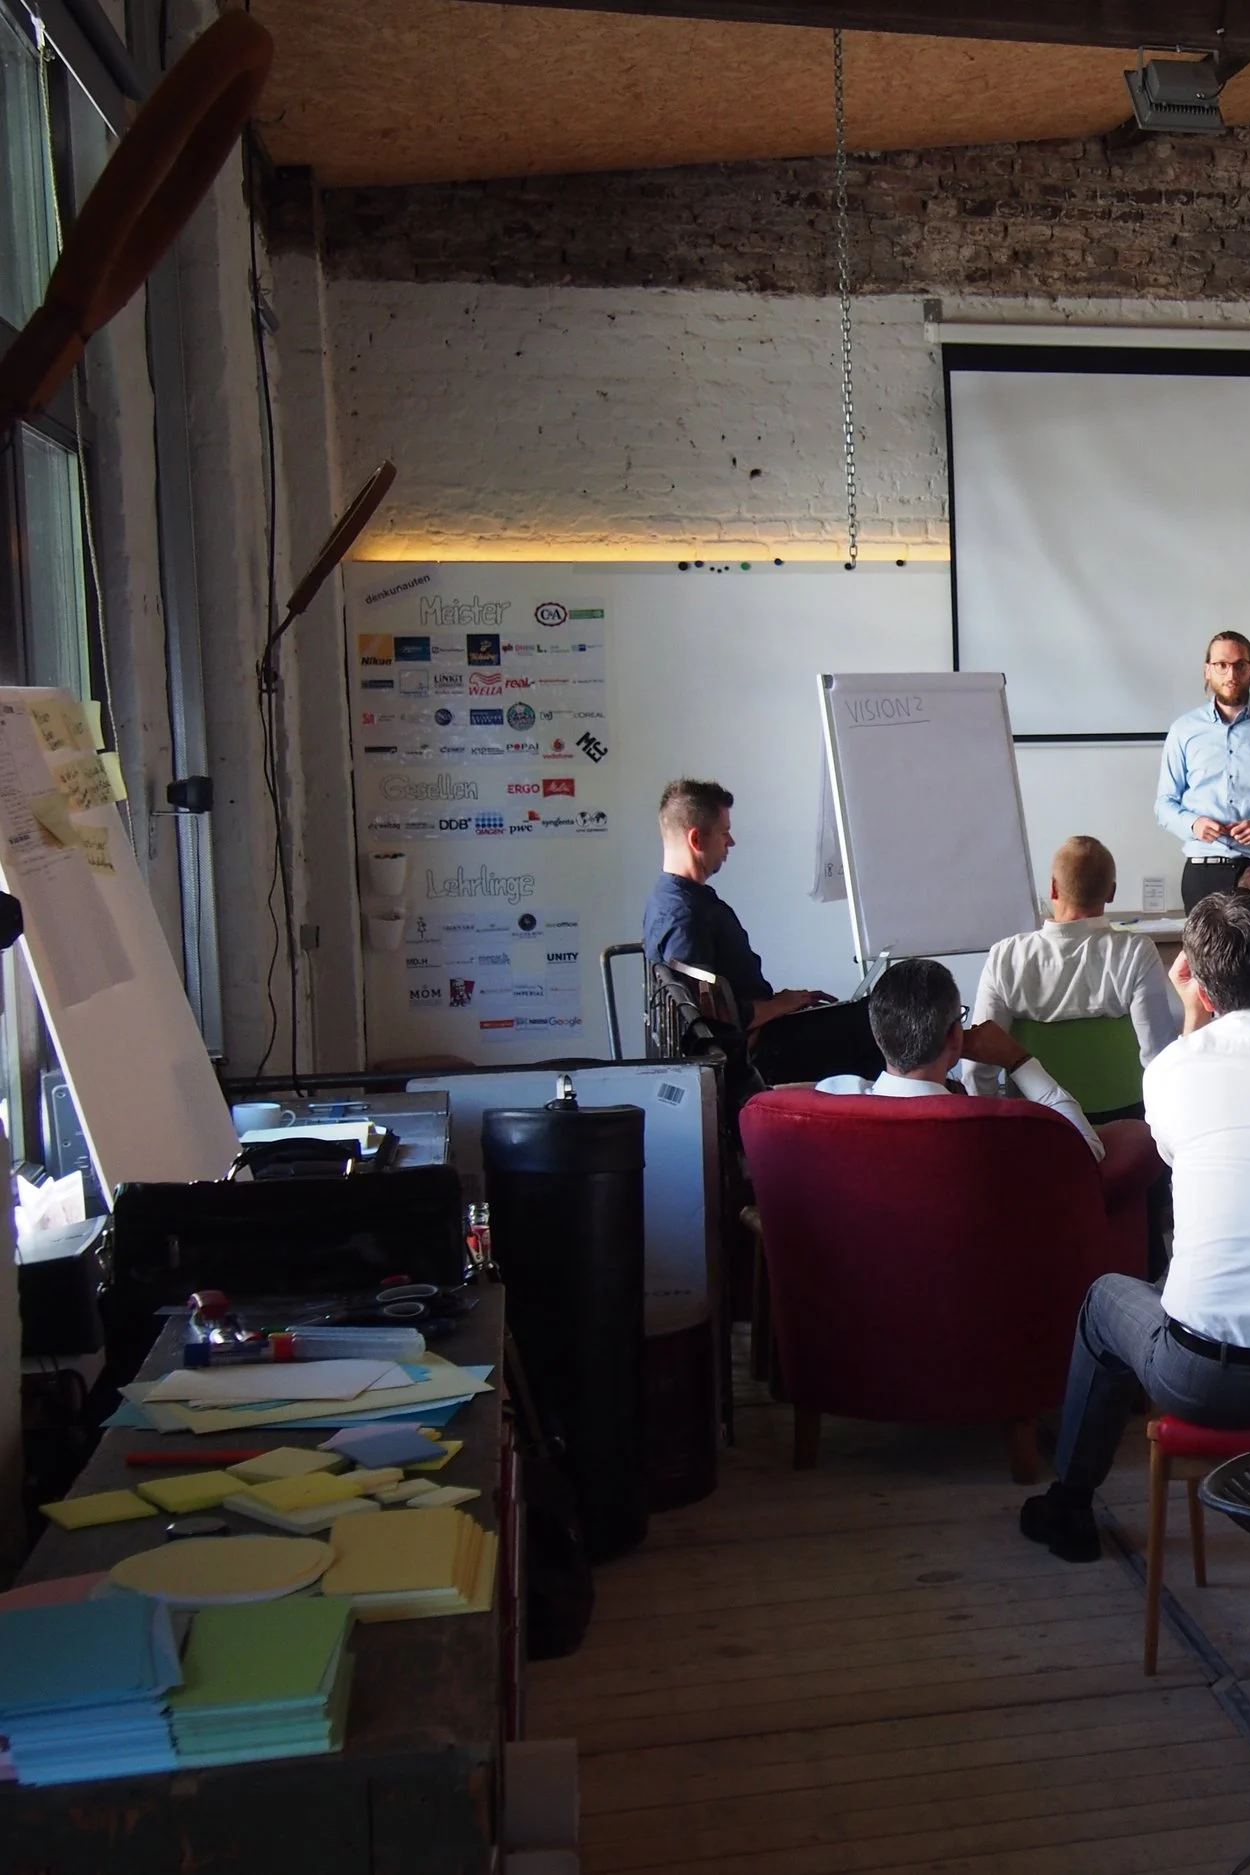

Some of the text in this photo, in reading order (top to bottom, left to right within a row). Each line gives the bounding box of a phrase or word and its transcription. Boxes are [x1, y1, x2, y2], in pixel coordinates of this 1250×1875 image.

[420, 595, 511, 626] Meister
[540, 609, 561, 620] C&A
[361, 656, 392, 666] Nikon
[469, 686, 503, 696] WELLA
[380, 773, 479, 800] Gesellen
[507, 784, 540, 794] ERGO
[542, 818, 574, 827] syngenta
[509, 824, 533, 835] pwc
[426, 864, 535, 905] Lehrlinge
[547, 952, 579, 961] UNITY
[549, 1016, 582, 1027] Google
